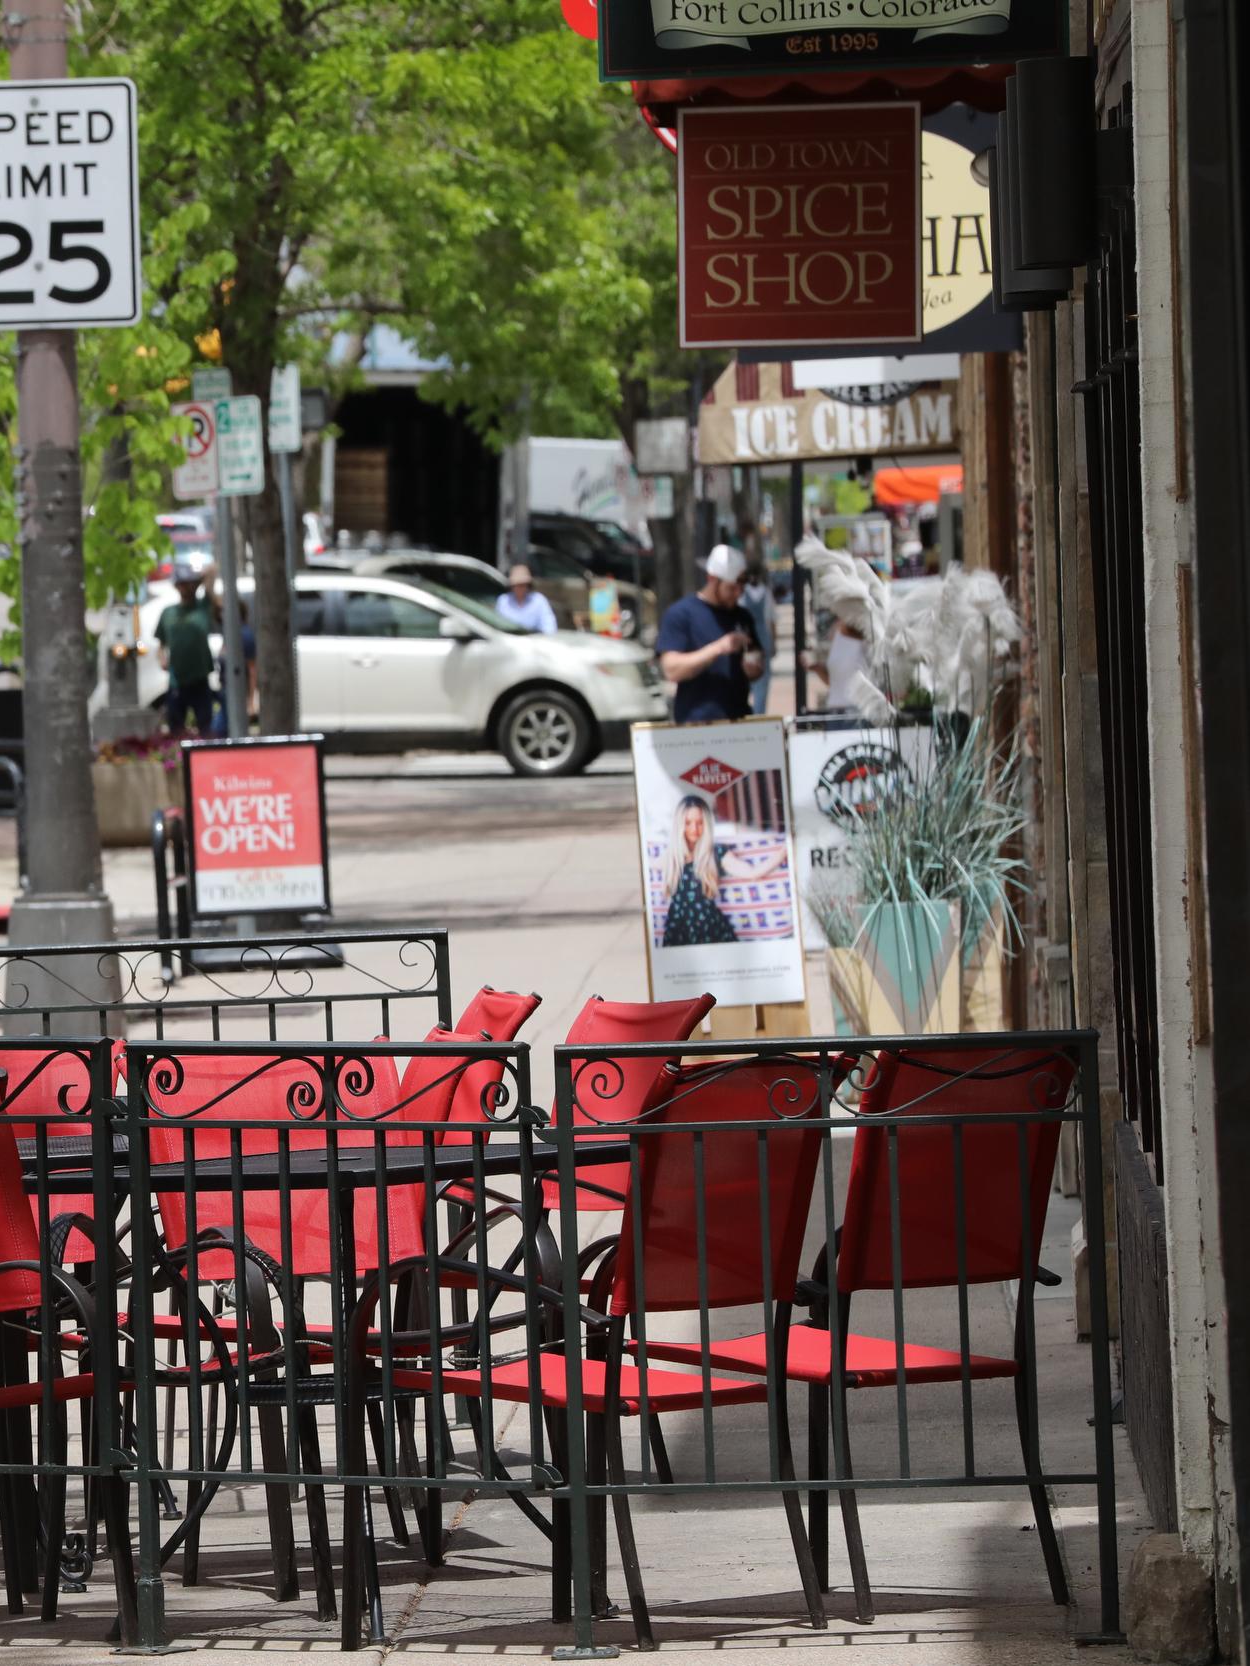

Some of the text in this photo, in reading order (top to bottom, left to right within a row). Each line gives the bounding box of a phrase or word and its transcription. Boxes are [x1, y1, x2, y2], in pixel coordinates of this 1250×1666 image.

[670, 0, 995, 25] Fort Collins Colora
[785, 32, 879, 54] Est 1995
[704, 140, 889, 171] OLD TOWN
[706, 182, 893, 240] SPICE
[704, 251, 893, 308] SHOP
[732, 394, 952, 458] ICE CREAM
[692, 773, 732, 785] HARVEST
[198, 793, 292, 824] WE'RE
[200, 822, 295, 854] OPEN!
